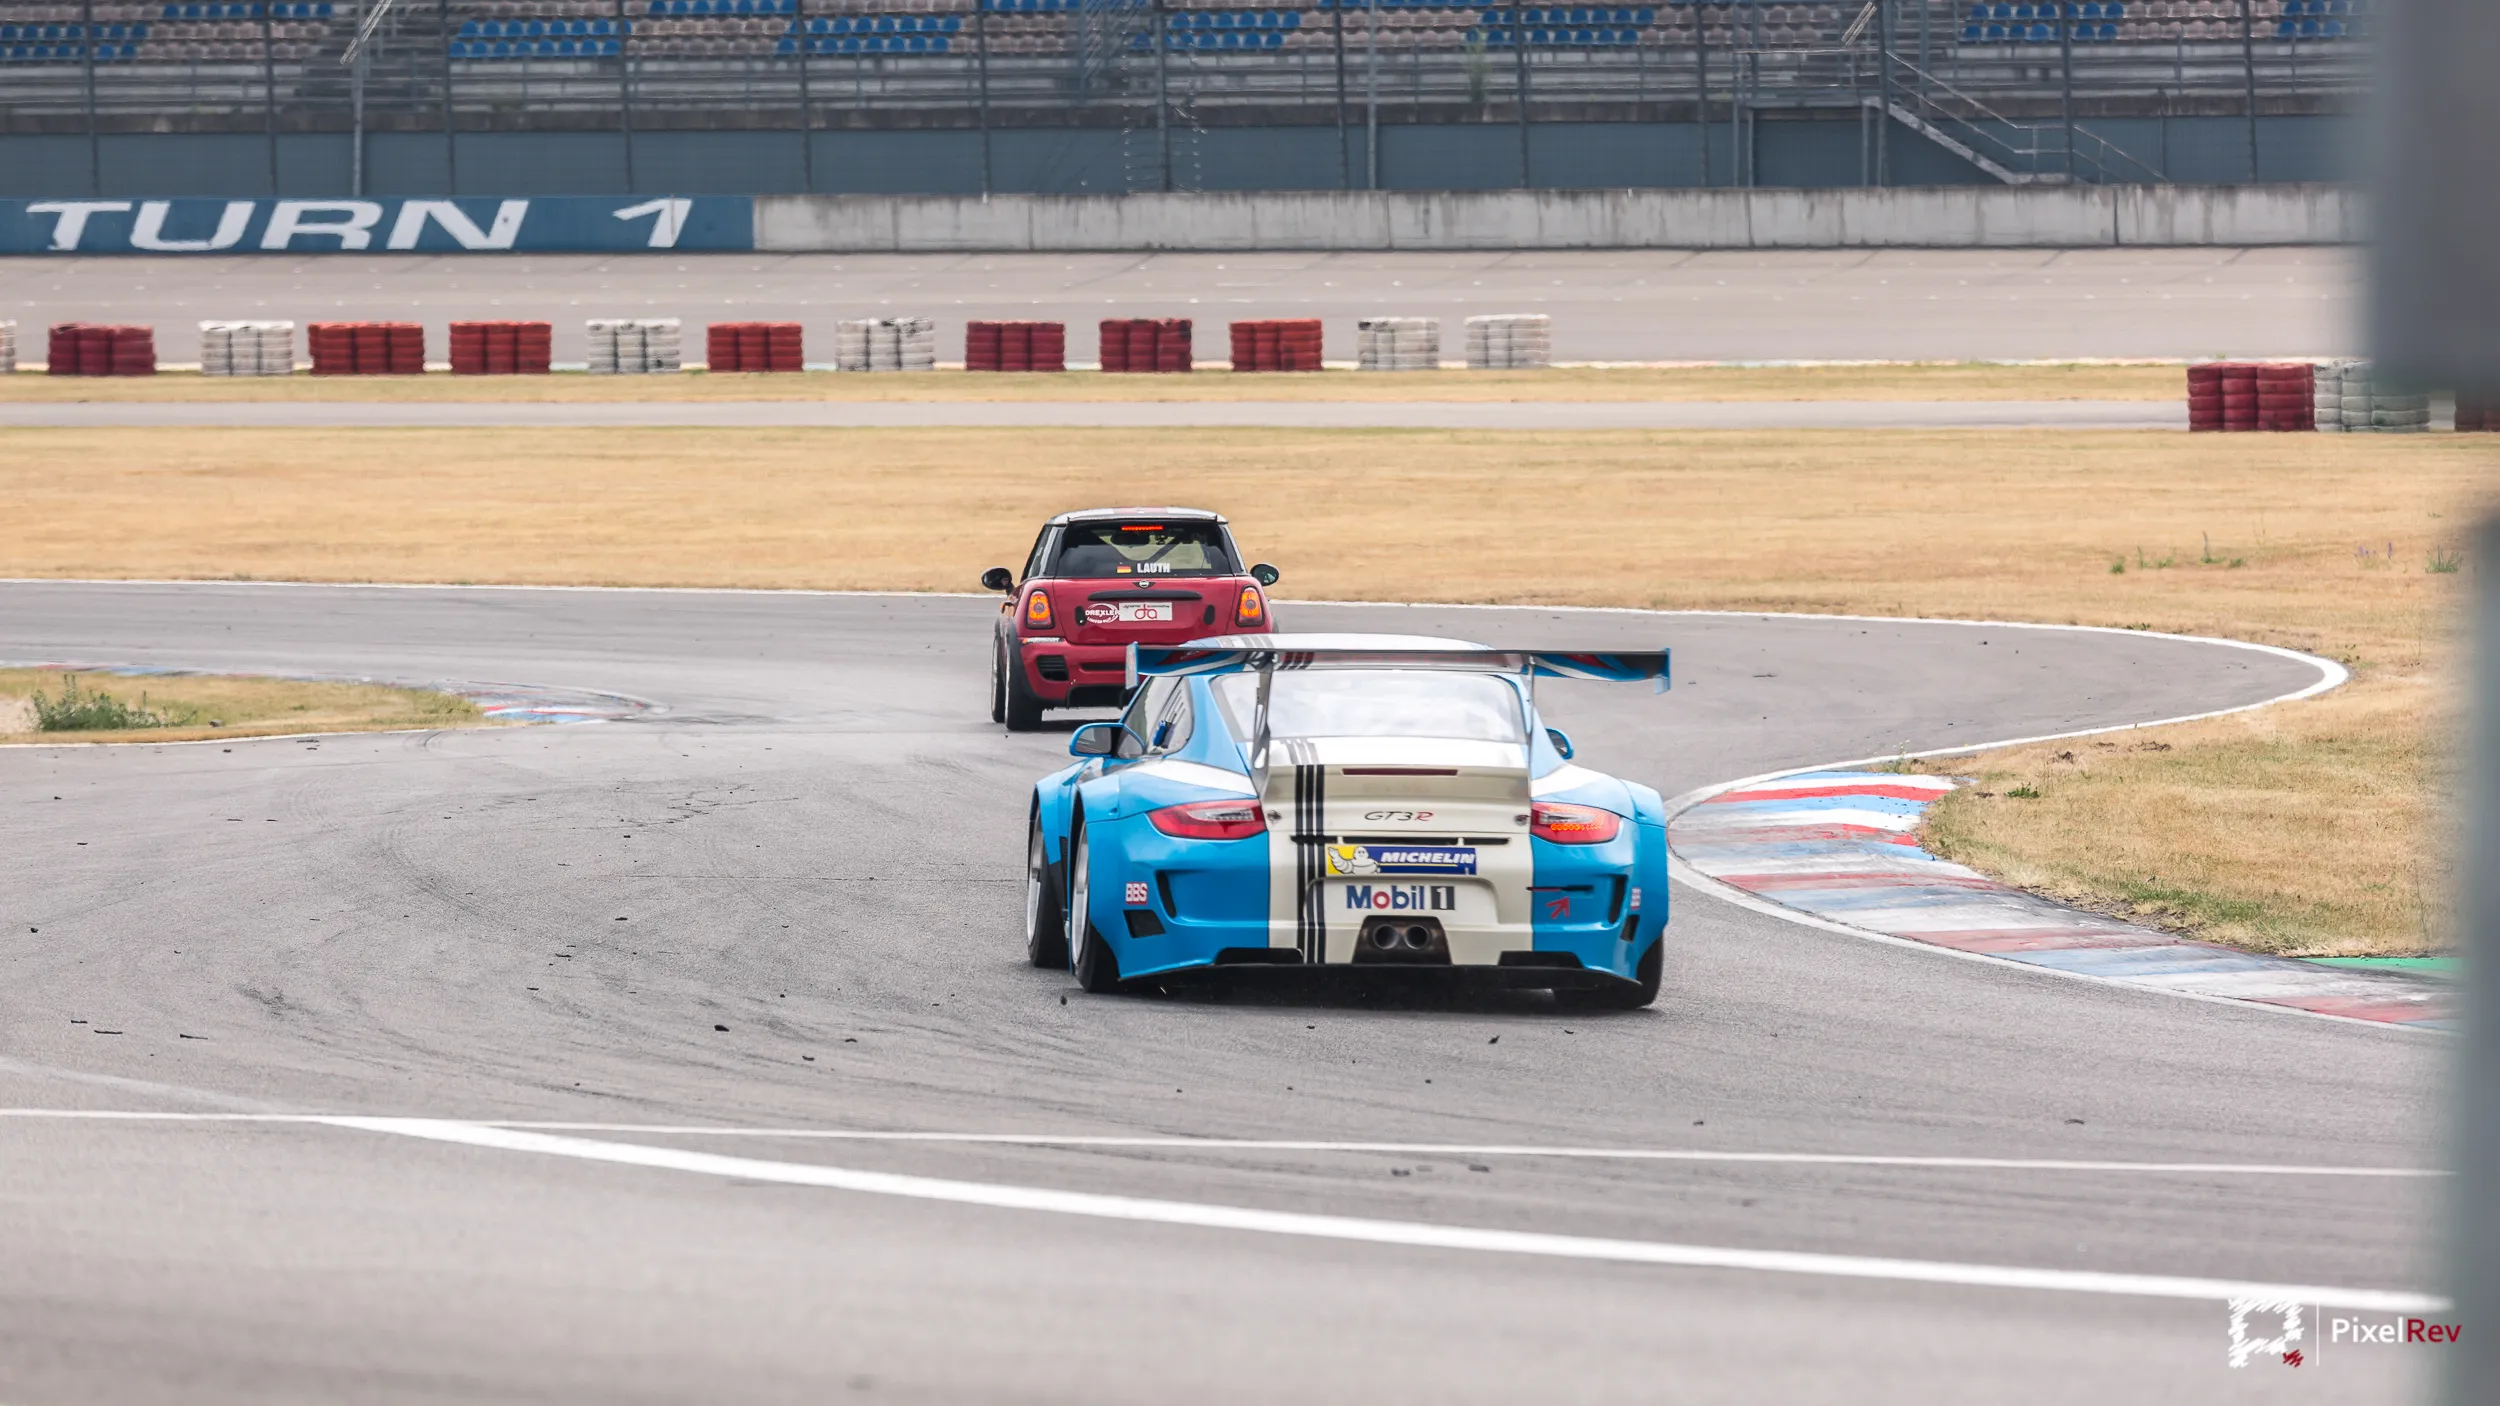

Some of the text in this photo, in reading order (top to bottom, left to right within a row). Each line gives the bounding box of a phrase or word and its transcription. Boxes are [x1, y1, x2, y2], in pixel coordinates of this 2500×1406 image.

[26, 199, 692, 251] TURN 1
[1136, 562, 1171, 574] LAUTH
[1380, 851, 1475, 864] MICHELIN
[1125, 883, 1148, 904] BBS
[1346, 885, 1450, 910] Mobil 1
